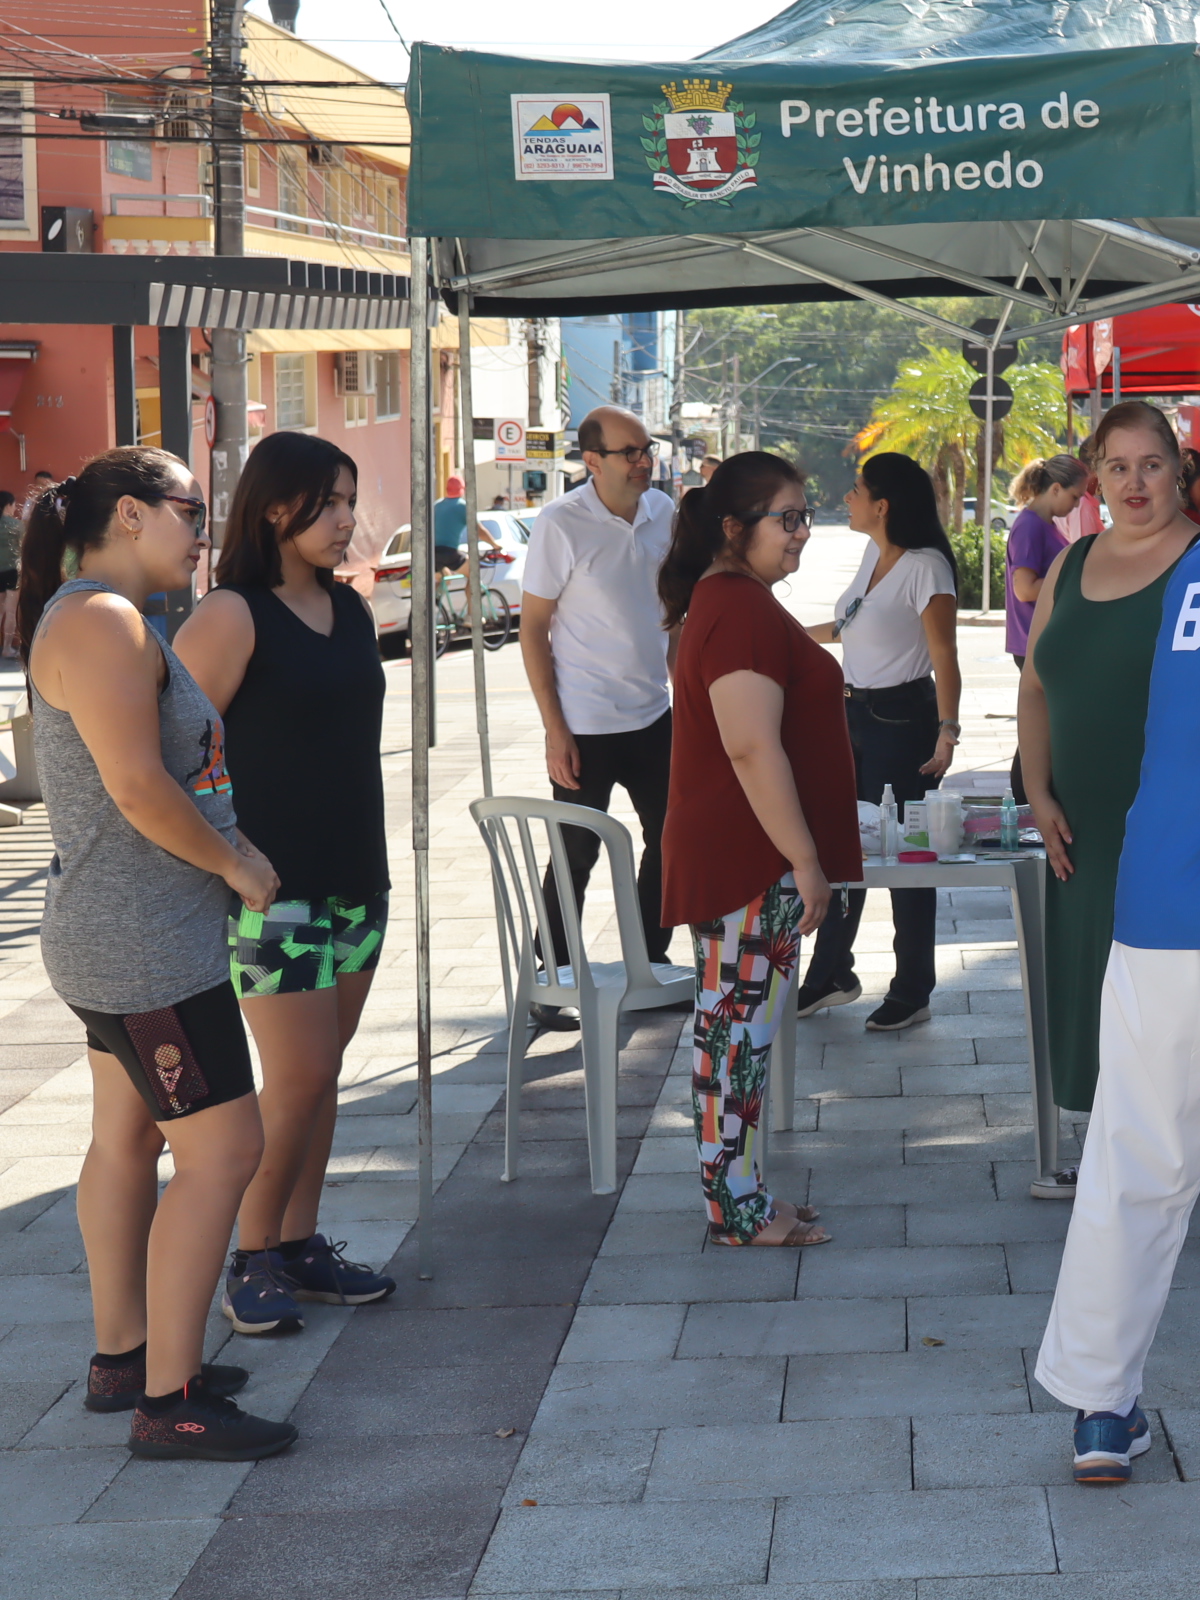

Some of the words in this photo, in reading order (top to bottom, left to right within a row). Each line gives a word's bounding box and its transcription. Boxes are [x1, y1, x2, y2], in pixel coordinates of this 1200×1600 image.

[779, 96, 1026, 138] Prefeitura
[1041, 91, 1100, 130] de
[523, 144, 603, 154] ARAGUAIA
[842, 150, 1044, 195] Vinhedo
[506, 427, 514, 440] E
